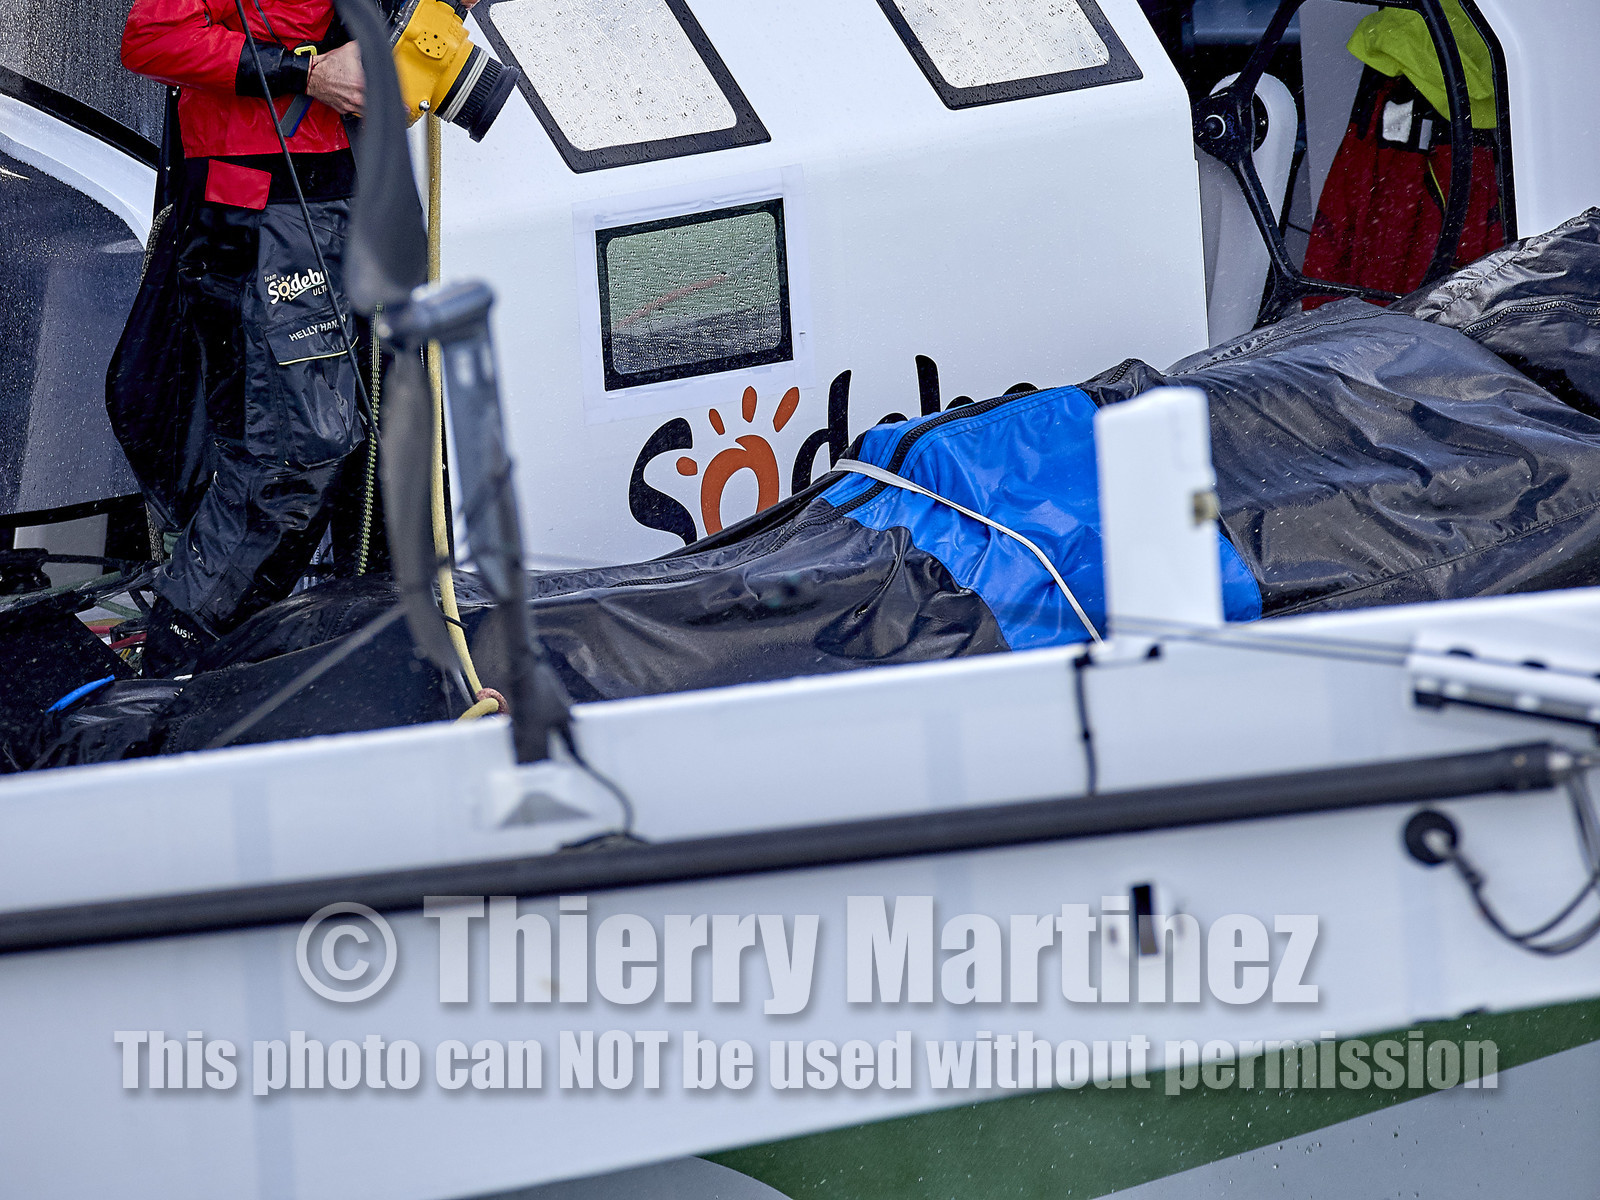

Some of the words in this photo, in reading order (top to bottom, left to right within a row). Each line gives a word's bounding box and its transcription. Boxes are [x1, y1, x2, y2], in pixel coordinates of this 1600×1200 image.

[312, 285, 328, 296] ULTI
[288, 324, 319, 342] HELLY
[319, 313, 347, 332] HANN
